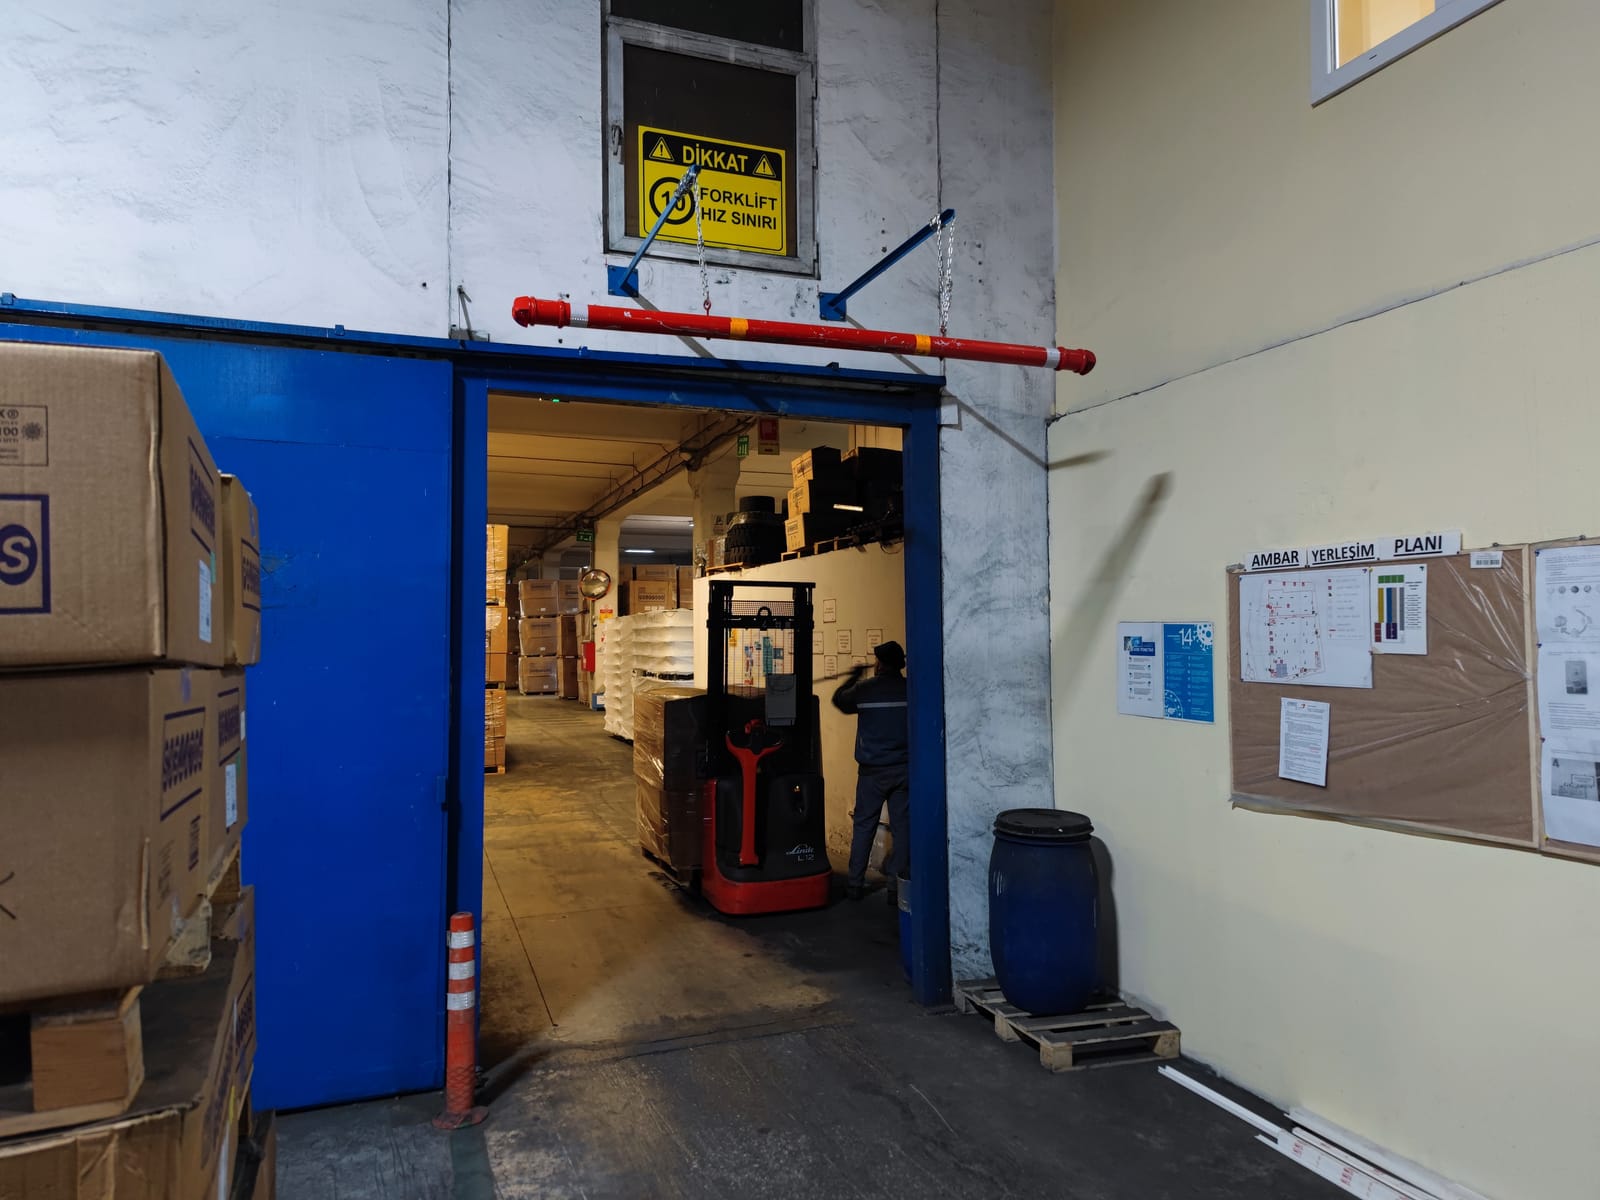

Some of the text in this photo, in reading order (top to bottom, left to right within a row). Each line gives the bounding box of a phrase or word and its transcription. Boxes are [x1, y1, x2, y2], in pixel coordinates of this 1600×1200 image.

[682, 143, 748, 173] DİKKAT
[700, 187, 778, 210] FORKLİFT
[701, 207, 776, 230] HIZ SINIRI
[1251, 535, 1442, 567] AMBAR YERLEŞİM PLANI
[1179, 627, 1193, 646] 14
